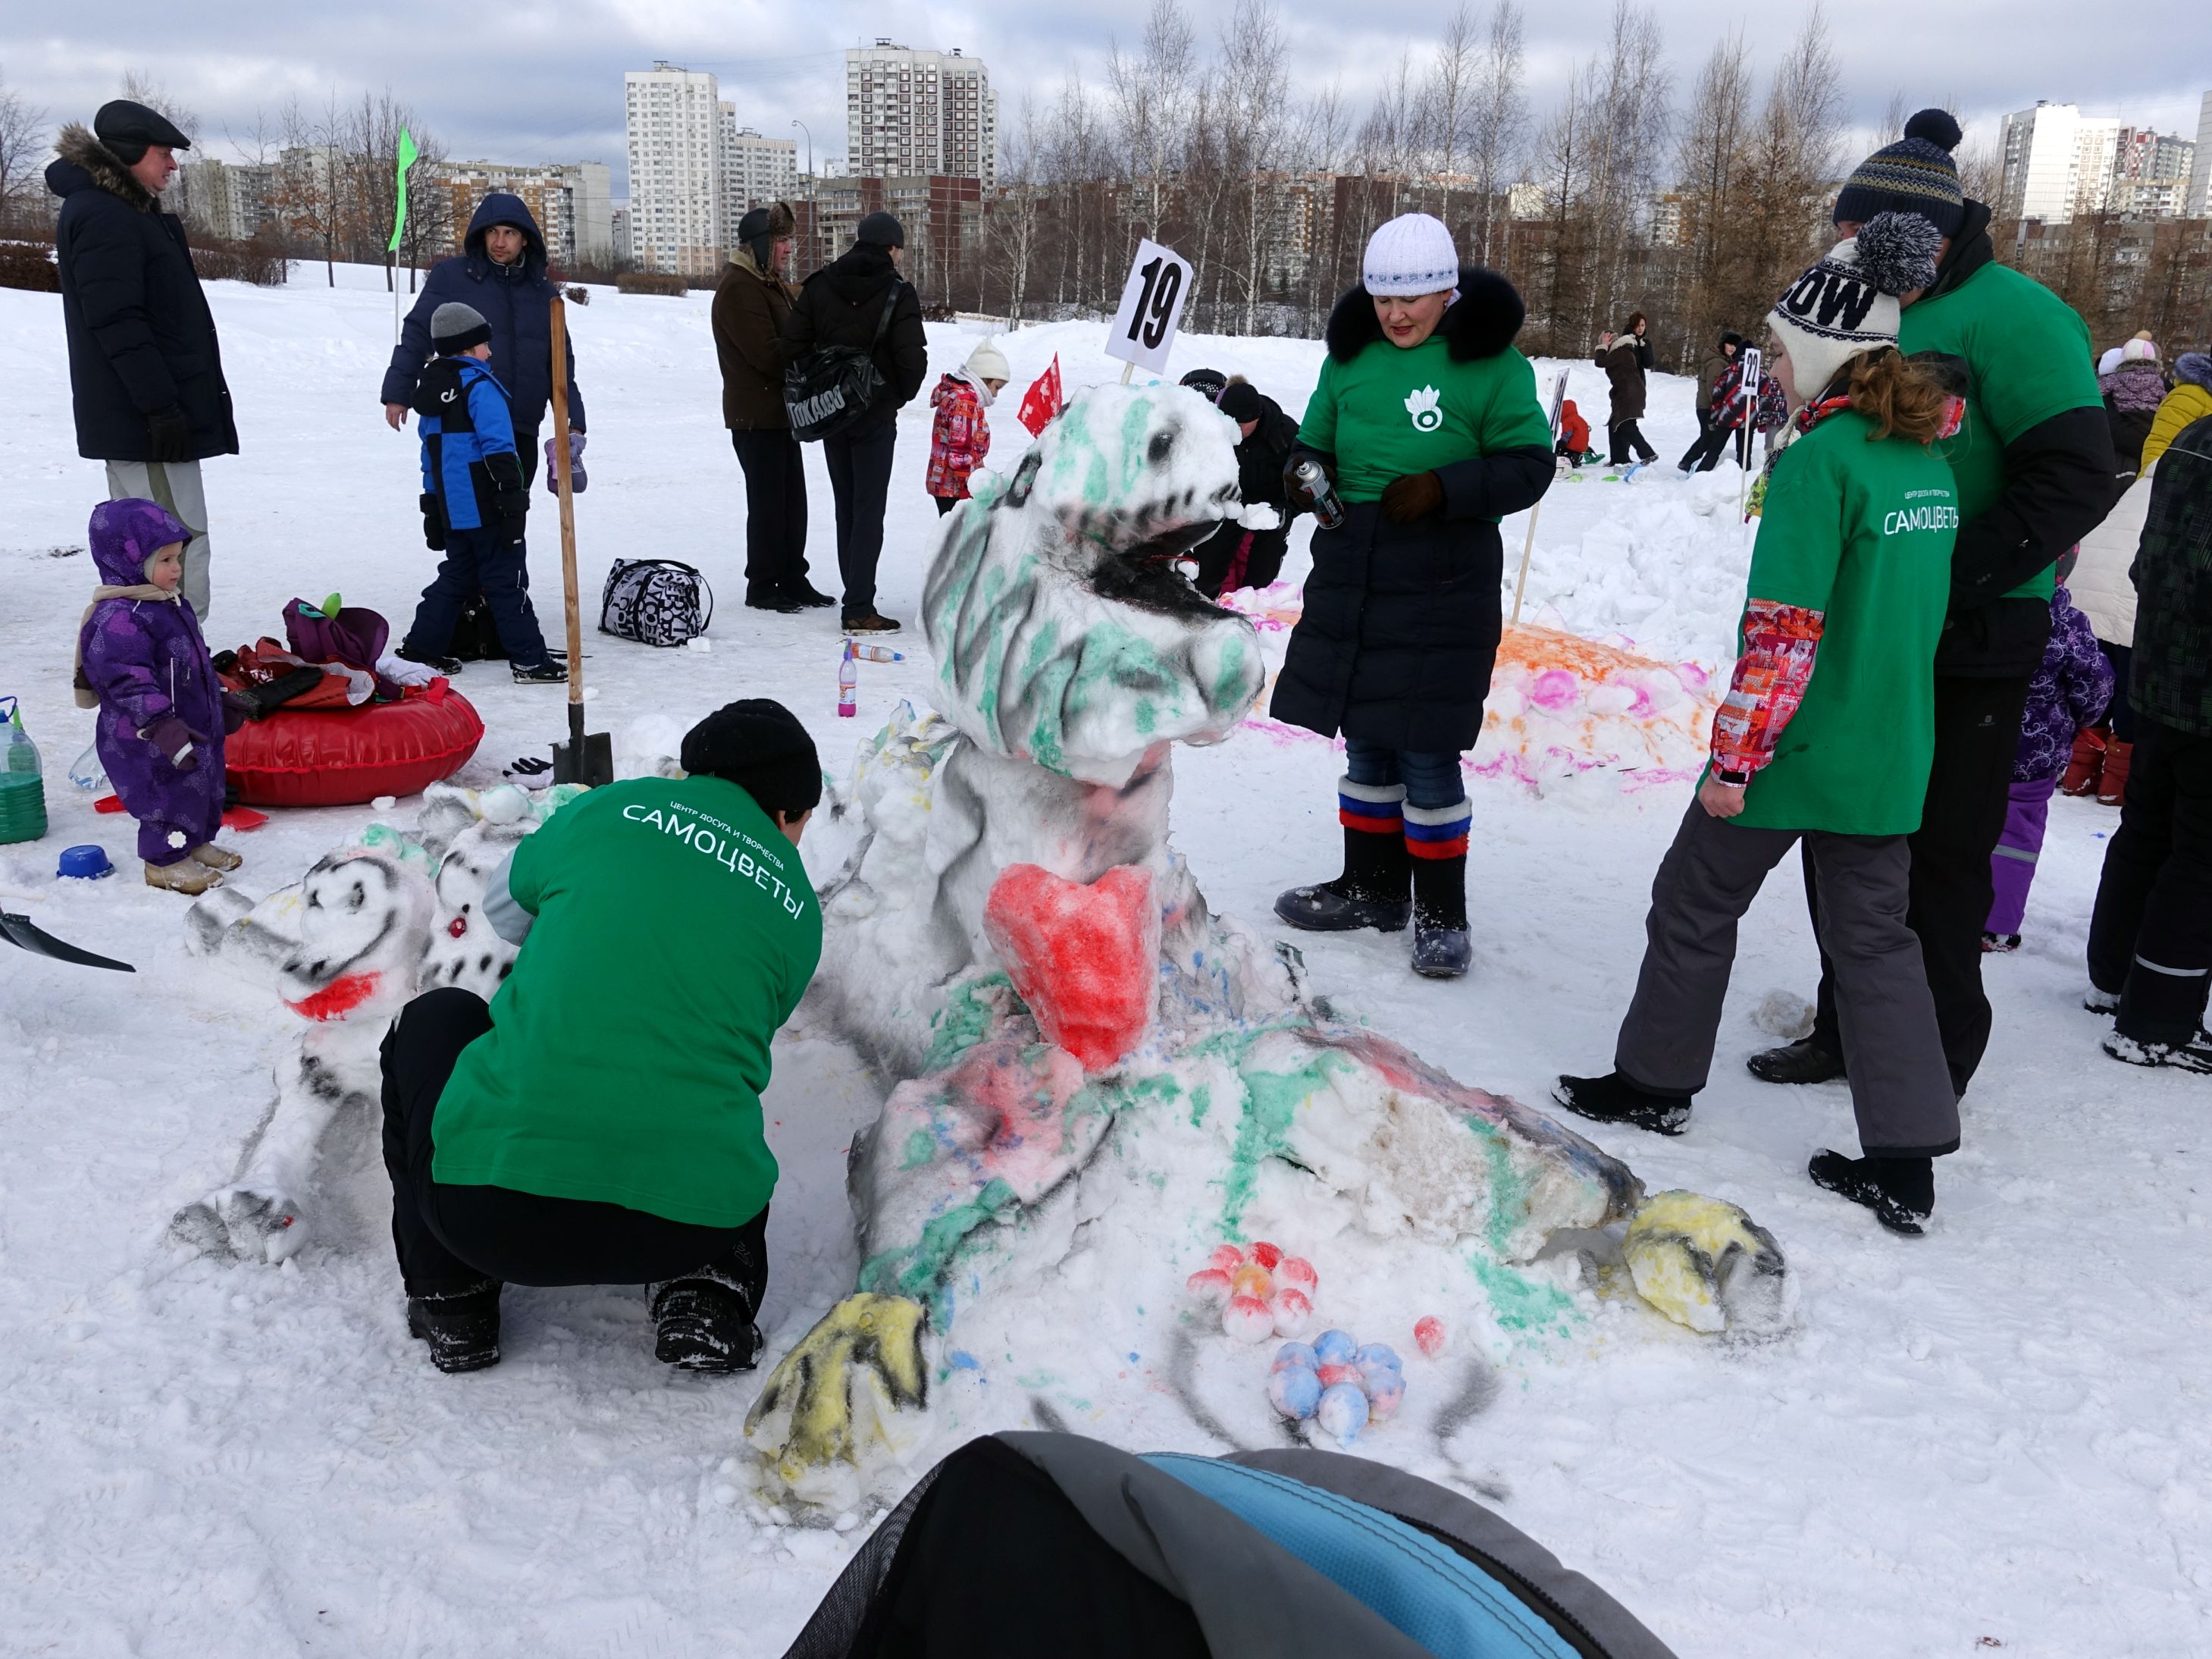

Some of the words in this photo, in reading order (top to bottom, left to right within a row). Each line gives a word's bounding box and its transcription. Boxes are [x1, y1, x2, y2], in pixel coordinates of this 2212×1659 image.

[1126, 256, 1182, 350] 19
[1745, 353, 1757, 387] 22
[787, 384, 845, 428] TOKAIDO
[622, 804, 804, 920] САМОЦВЕТЫ
[670, 801, 698, 815] ЦЕНТР
[699, 813, 731, 833] ДОСУГА
[733, 830, 740, 838] И
[742, 834, 784, 871] ТВОРЧЕСТВА
